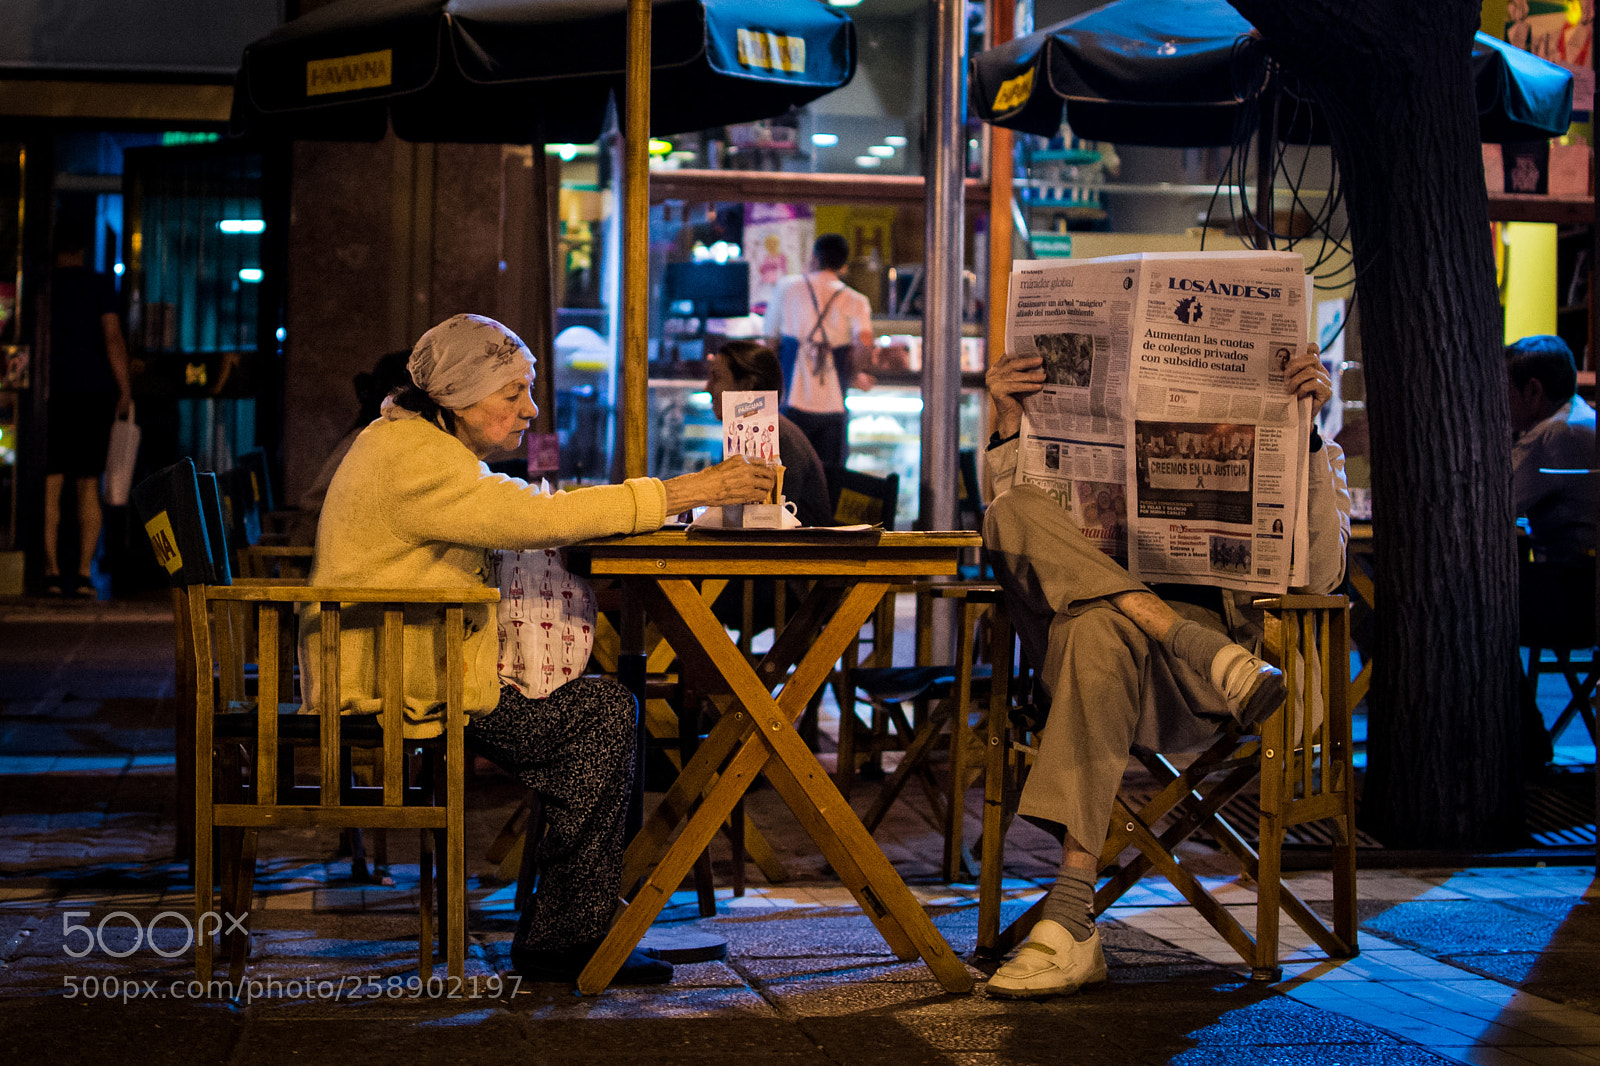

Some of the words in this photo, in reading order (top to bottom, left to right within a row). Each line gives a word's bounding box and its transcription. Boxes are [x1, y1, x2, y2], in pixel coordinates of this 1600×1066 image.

[1019, 277, 1049, 289] mirador
[1050, 276, 1075, 291] global
[1144, 328, 1201, 344] Aumentan
[1203, 334, 1218, 346] las
[1220, 338, 1255, 350] cuotas
[1142, 340, 1156, 351] de
[1158, 343, 1202, 356] colegios
[1203, 348, 1249, 362] privados
[1141, 353, 1161, 364] con
[1163, 354, 1209, 369] subsidio
[1210, 361, 1246, 373] estatal
[1150, 461, 1188, 475] CREEMOS
[1189, 463, 1200, 475] EN
[1202, 463, 1213, 476] LA
[1214, 463, 1247, 477] JUSTICIA
